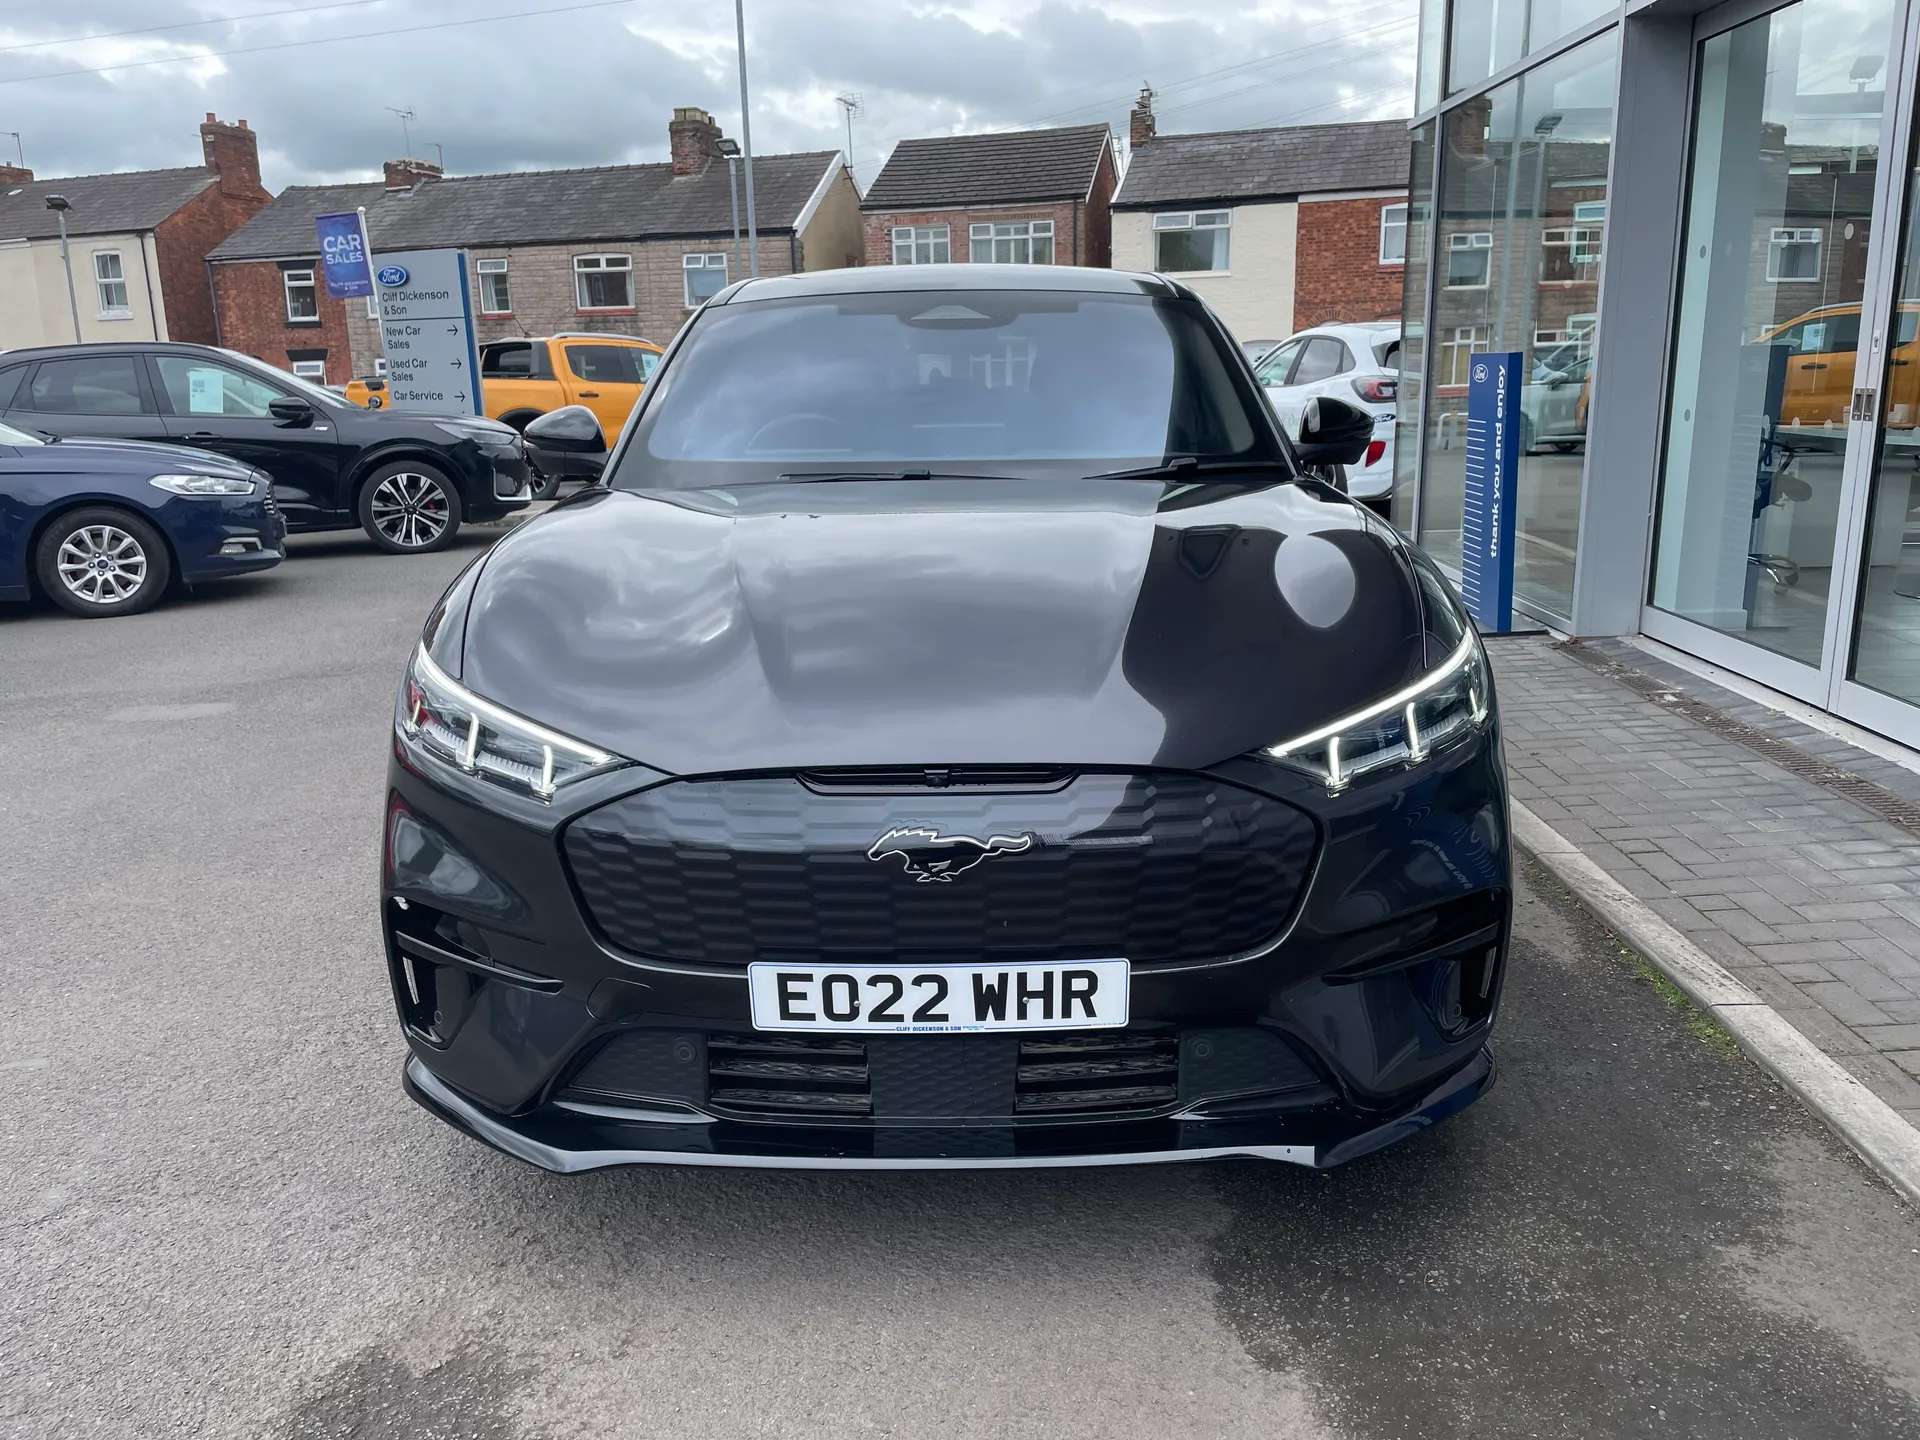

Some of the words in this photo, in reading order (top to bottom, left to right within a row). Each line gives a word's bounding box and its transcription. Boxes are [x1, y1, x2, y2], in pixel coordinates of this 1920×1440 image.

[323, 233, 361, 252] CAR
[325, 251, 364, 265] SALES
[382, 292, 398, 303] Cliff
[399, 290, 449, 301] Dickenson
[384, 306, 390, 316] &
[390, 305, 407, 315] Son
[386, 327, 404, 337] New
[405, 325, 421, 336] Car
[387, 339, 410, 350] Sales
[389, 359, 410, 369] Used
[411, 358, 428, 369] Car
[391, 371, 414, 382] Sales
[393, 390, 408, 401] Car
[408, 390, 444, 401] Service
[1496, 364, 1506, 419] enjoy
[1495, 422, 1503, 460] and
[1493, 463, 1501, 500] you
[1490, 503, 1499, 559] thank
[775, 972, 950, 1022] EO22
[971, 969, 1098, 1022] WHR
